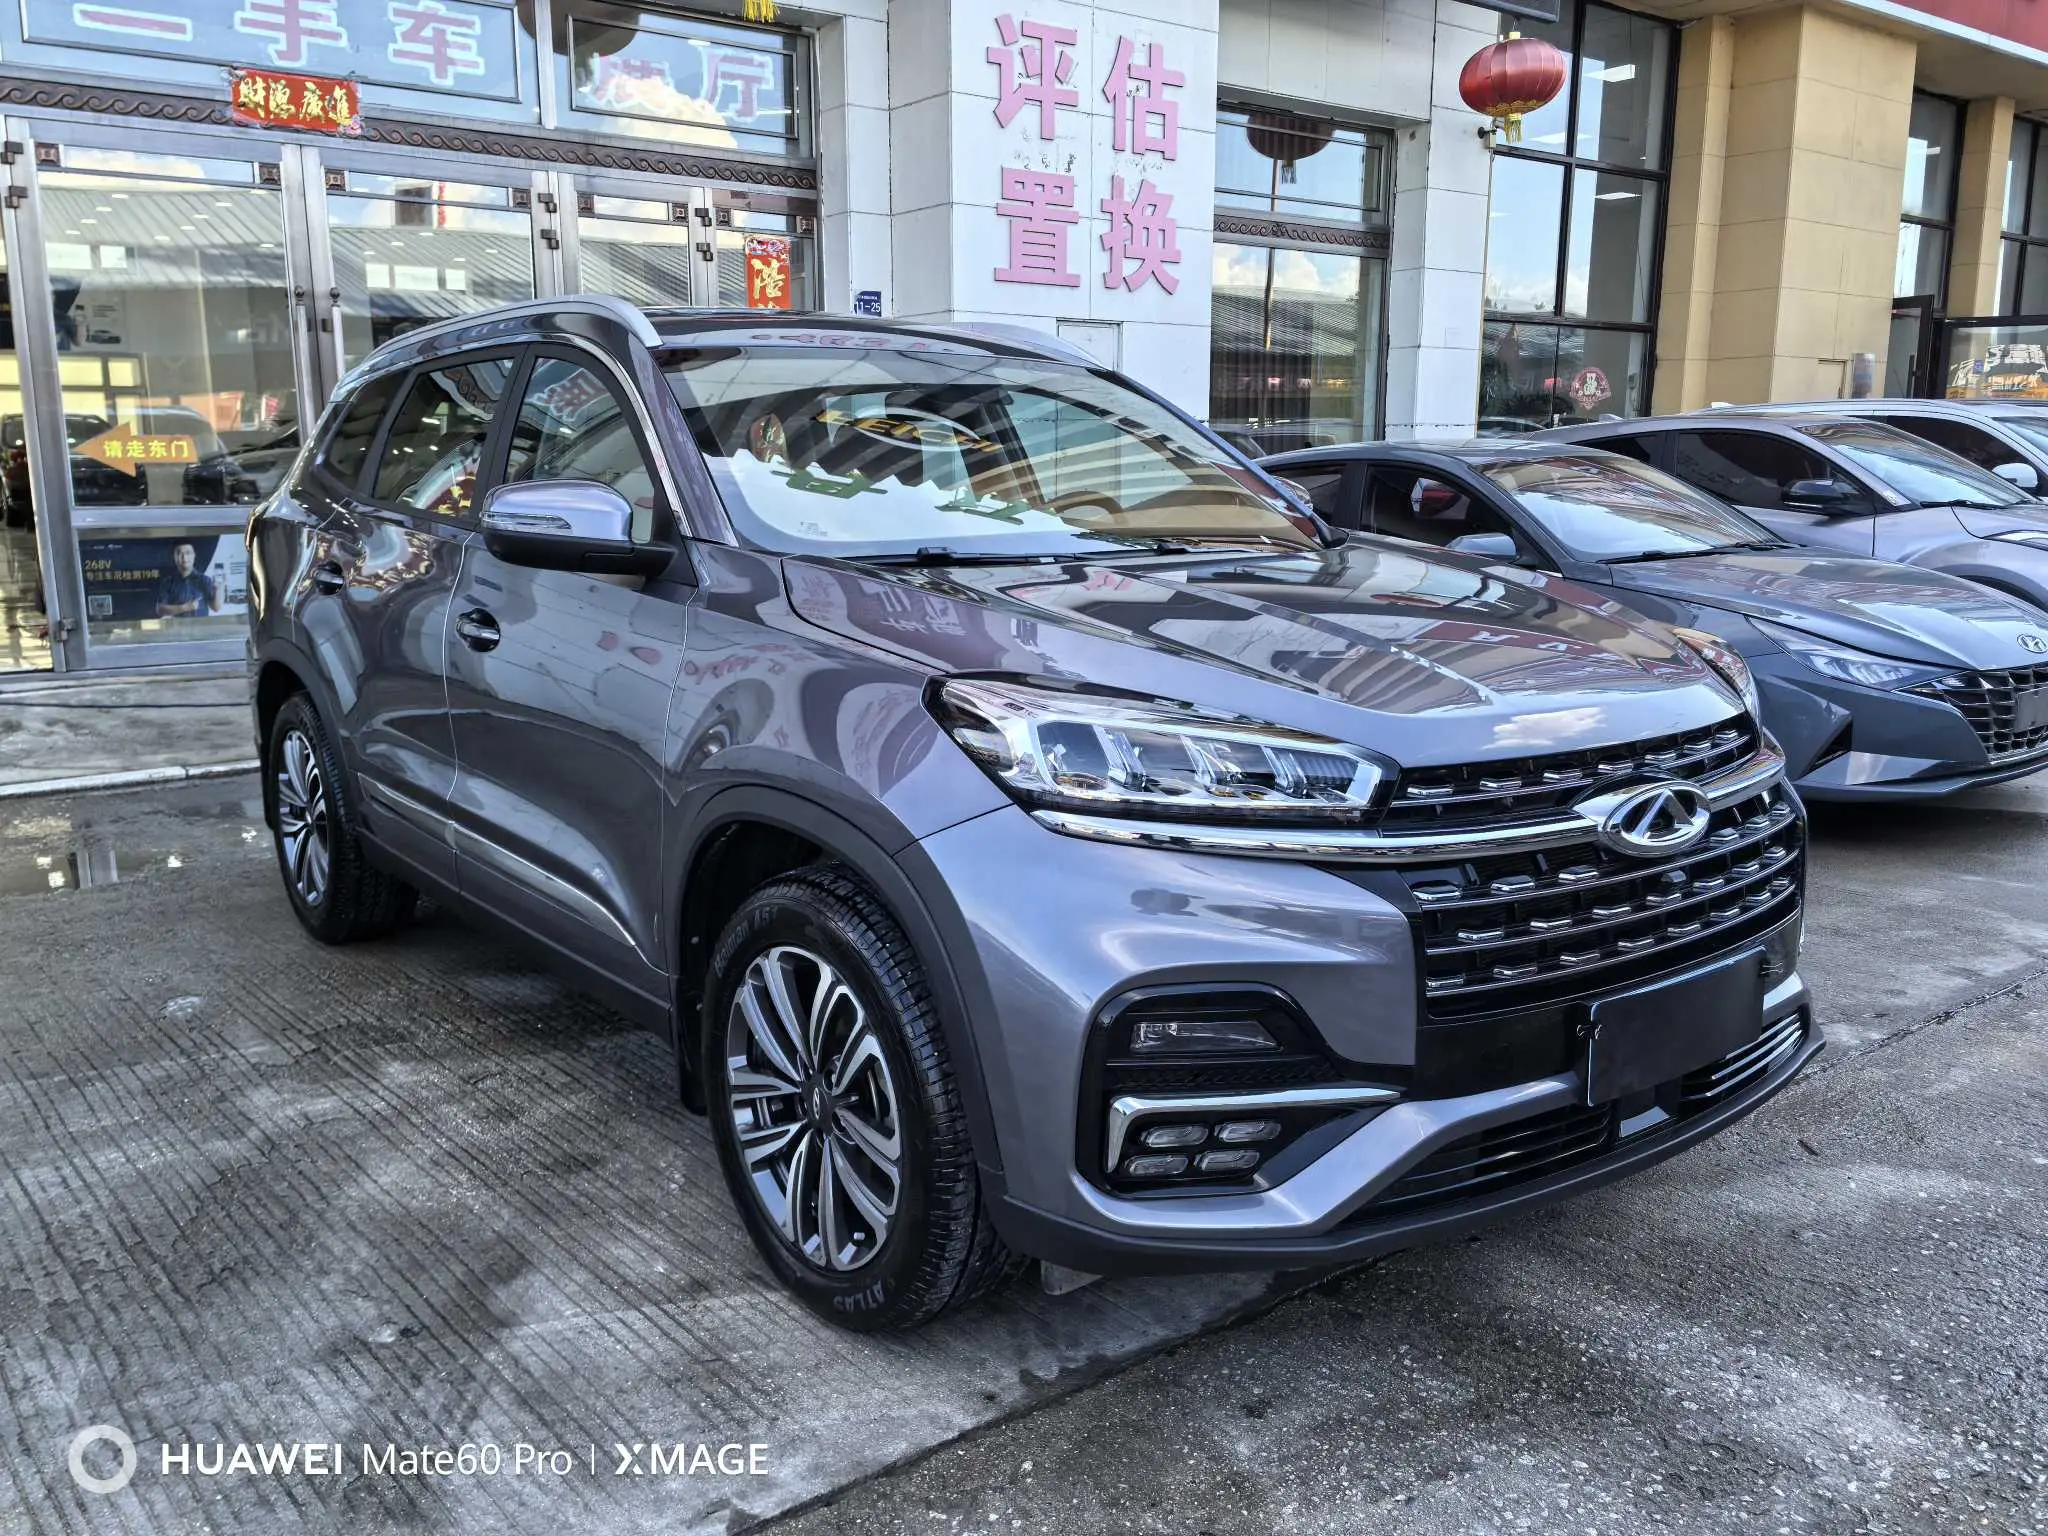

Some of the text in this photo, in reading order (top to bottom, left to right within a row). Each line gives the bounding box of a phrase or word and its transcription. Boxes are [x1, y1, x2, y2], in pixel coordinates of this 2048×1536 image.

[987, 14, 1185, 161] 评估
[994, 167, 1181, 295] 置换
[104, 440, 189, 458] 请走东门
[832, 1279, 886, 1313] ATLAS
